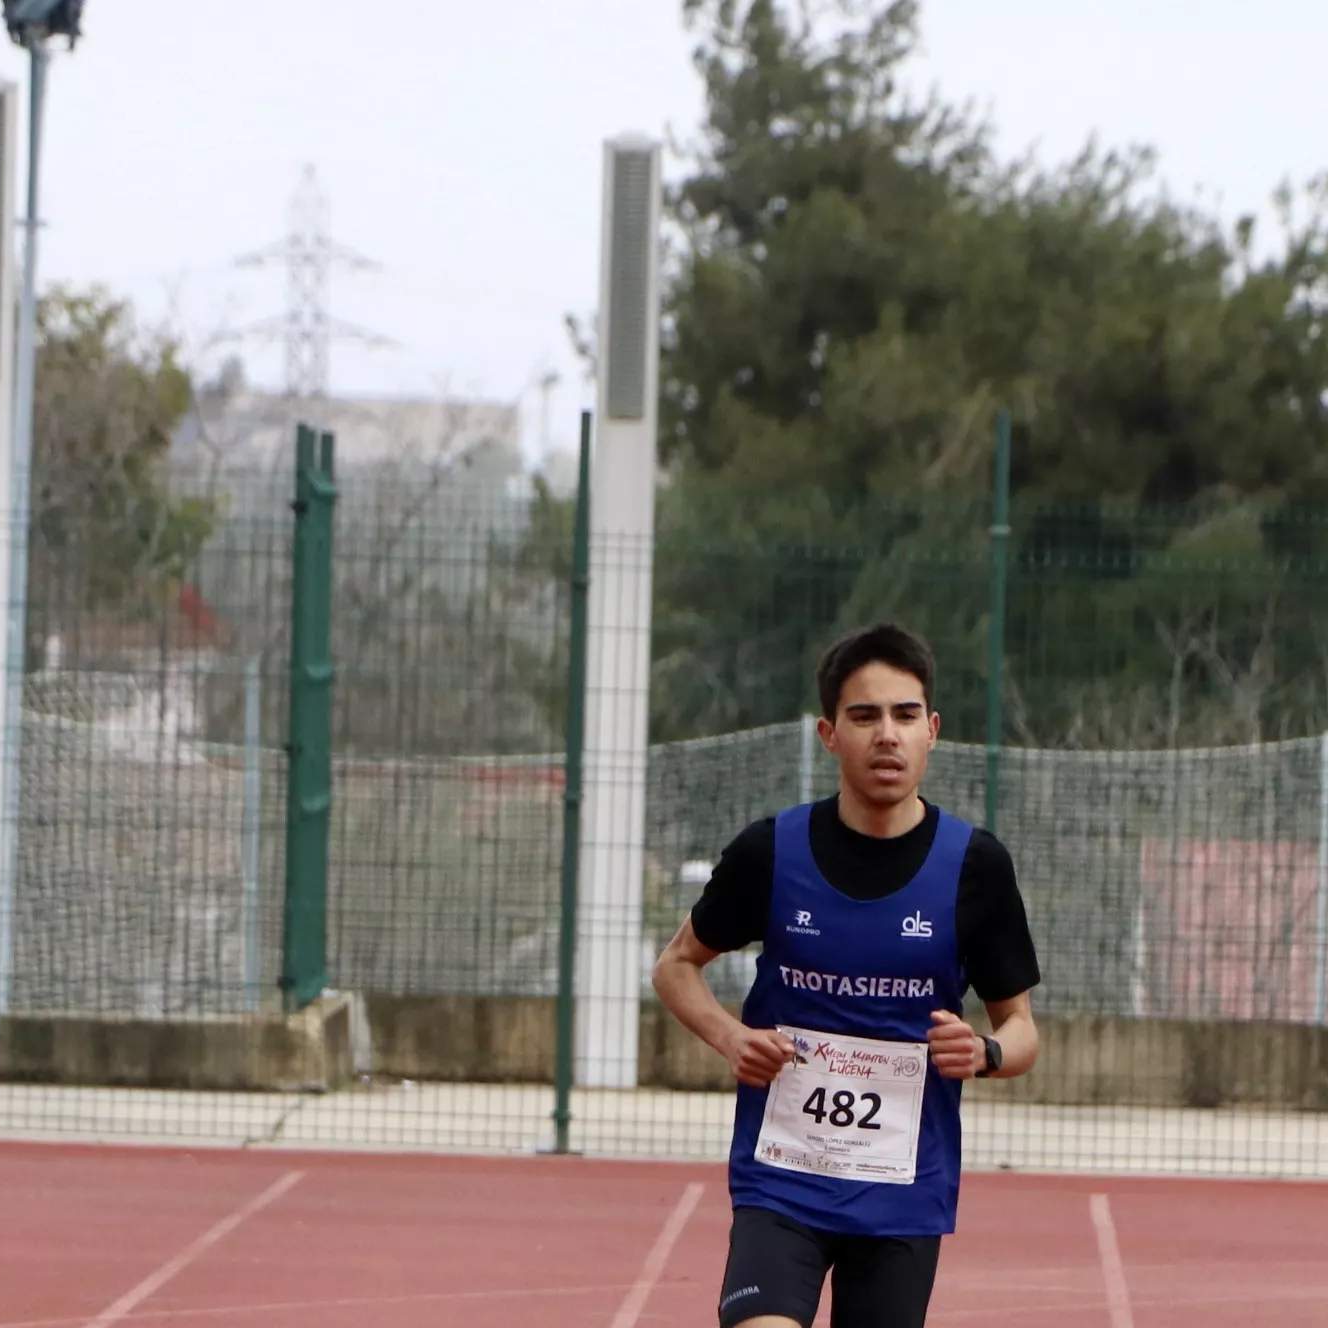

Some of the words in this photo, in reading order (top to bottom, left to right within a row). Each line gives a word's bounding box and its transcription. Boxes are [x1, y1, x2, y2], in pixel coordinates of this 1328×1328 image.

[779, 965, 935, 998] TROTASIERRA
[829, 1060, 878, 1080] LUCENA
[802, 1086, 882, 1130] 482
